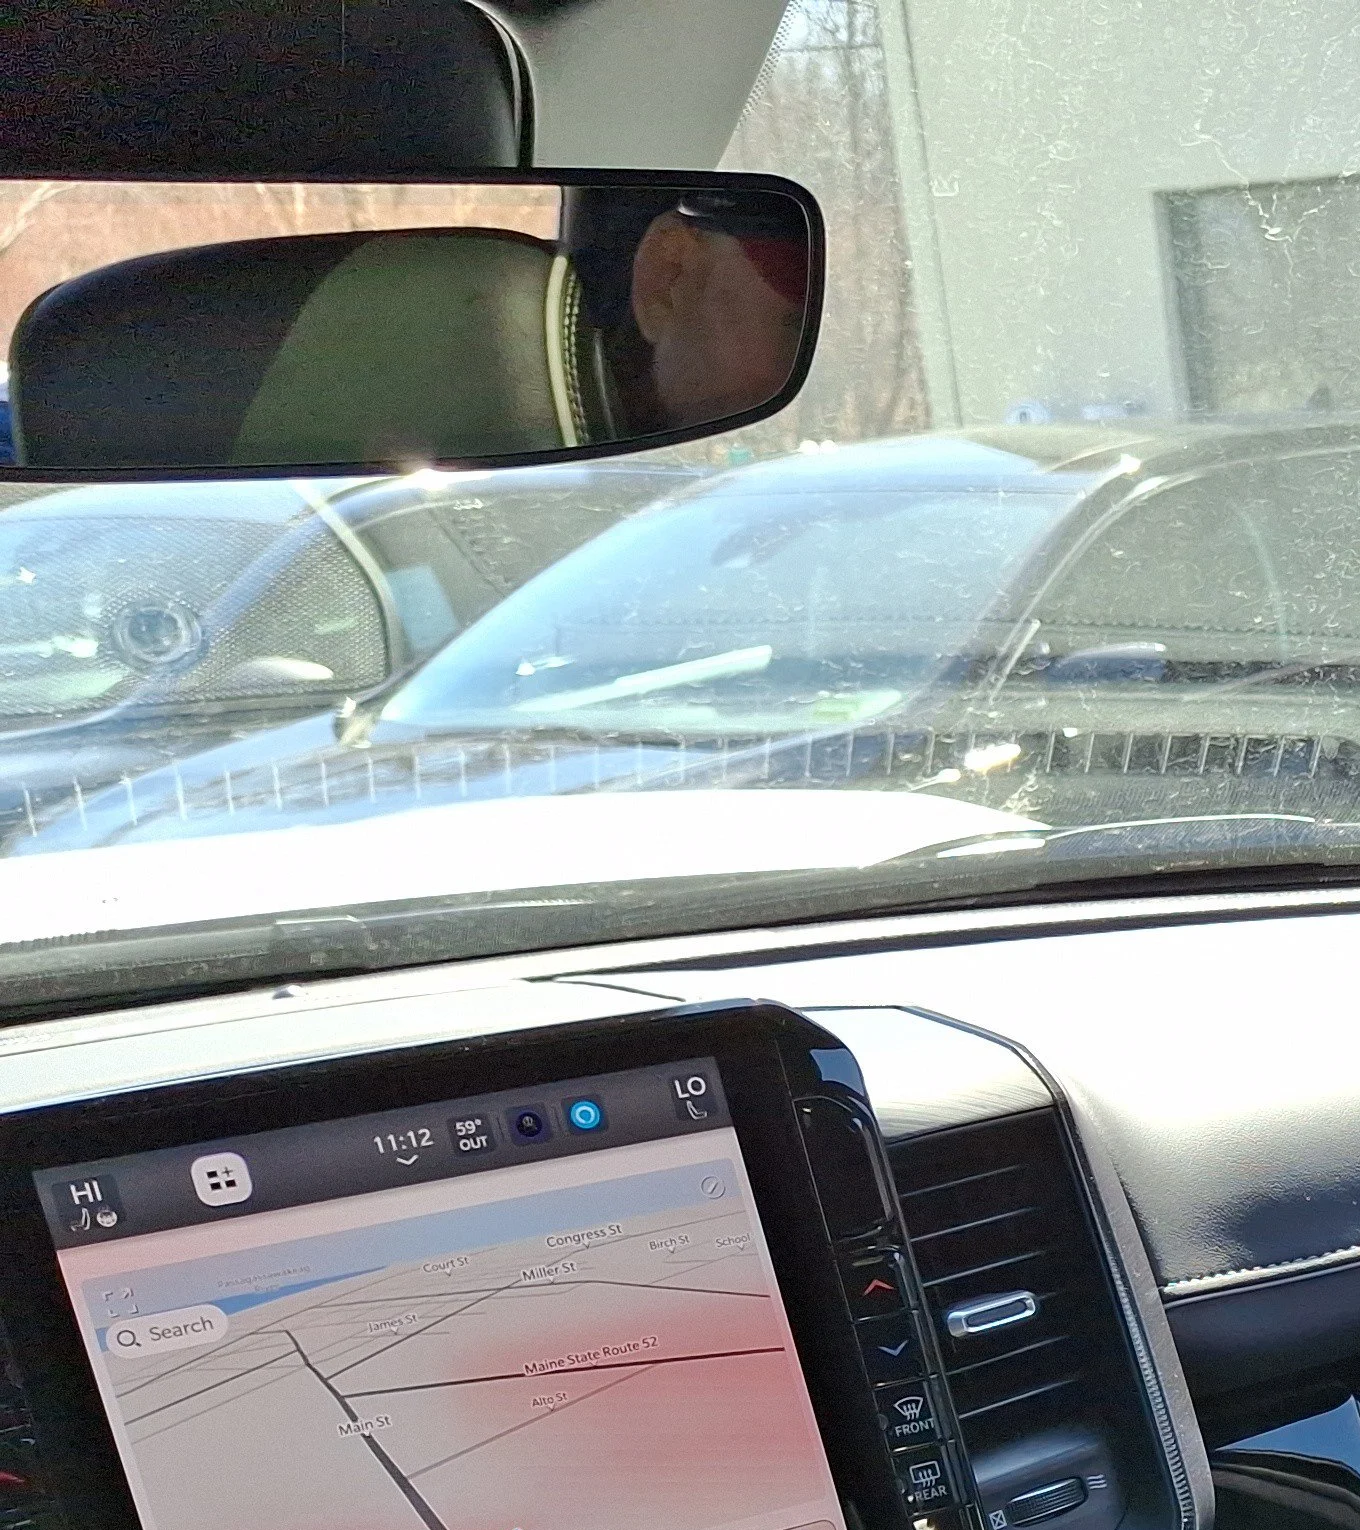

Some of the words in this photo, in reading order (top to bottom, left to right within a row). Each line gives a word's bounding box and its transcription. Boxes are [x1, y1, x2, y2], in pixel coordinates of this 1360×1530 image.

[674, 1076, 706, 1099] LO
[373, 1128, 434, 1154] 11:12
[459, 1135, 488, 1151] OUT
[69, 1179, 103, 1204] HI
[546, 1227, 606, 1249] Congress
[608, 1224, 622, 1236] St
[649, 1236, 678, 1252] Birch
[679, 1234, 690, 1245] St
[715, 1233, 751, 1248] School
[423, 1259, 454, 1273] Court
[455, 1256, 470, 1267] St
[522, 1265, 559, 1282] Miller
[561, 1262, 577, 1274] St
[149, 1318, 214, 1341] Search
[367, 1317, 404, 1334] James
[405, 1314, 418, 1325] St
[524, 1359, 565, 1375] Maine
[567, 1350, 600, 1367] State
[602, 1341, 640, 1358] Route
[642, 1337, 658, 1349] 52
[532, 1395, 556, 1408] Alto
[556, 1391, 568, 1402] St
[339, 1419, 374, 1437] Main
[376, 1415, 392, 1427] St
[894, 1418, 936, 1440] FRONT
[914, 1485, 949, 1502] REAR
